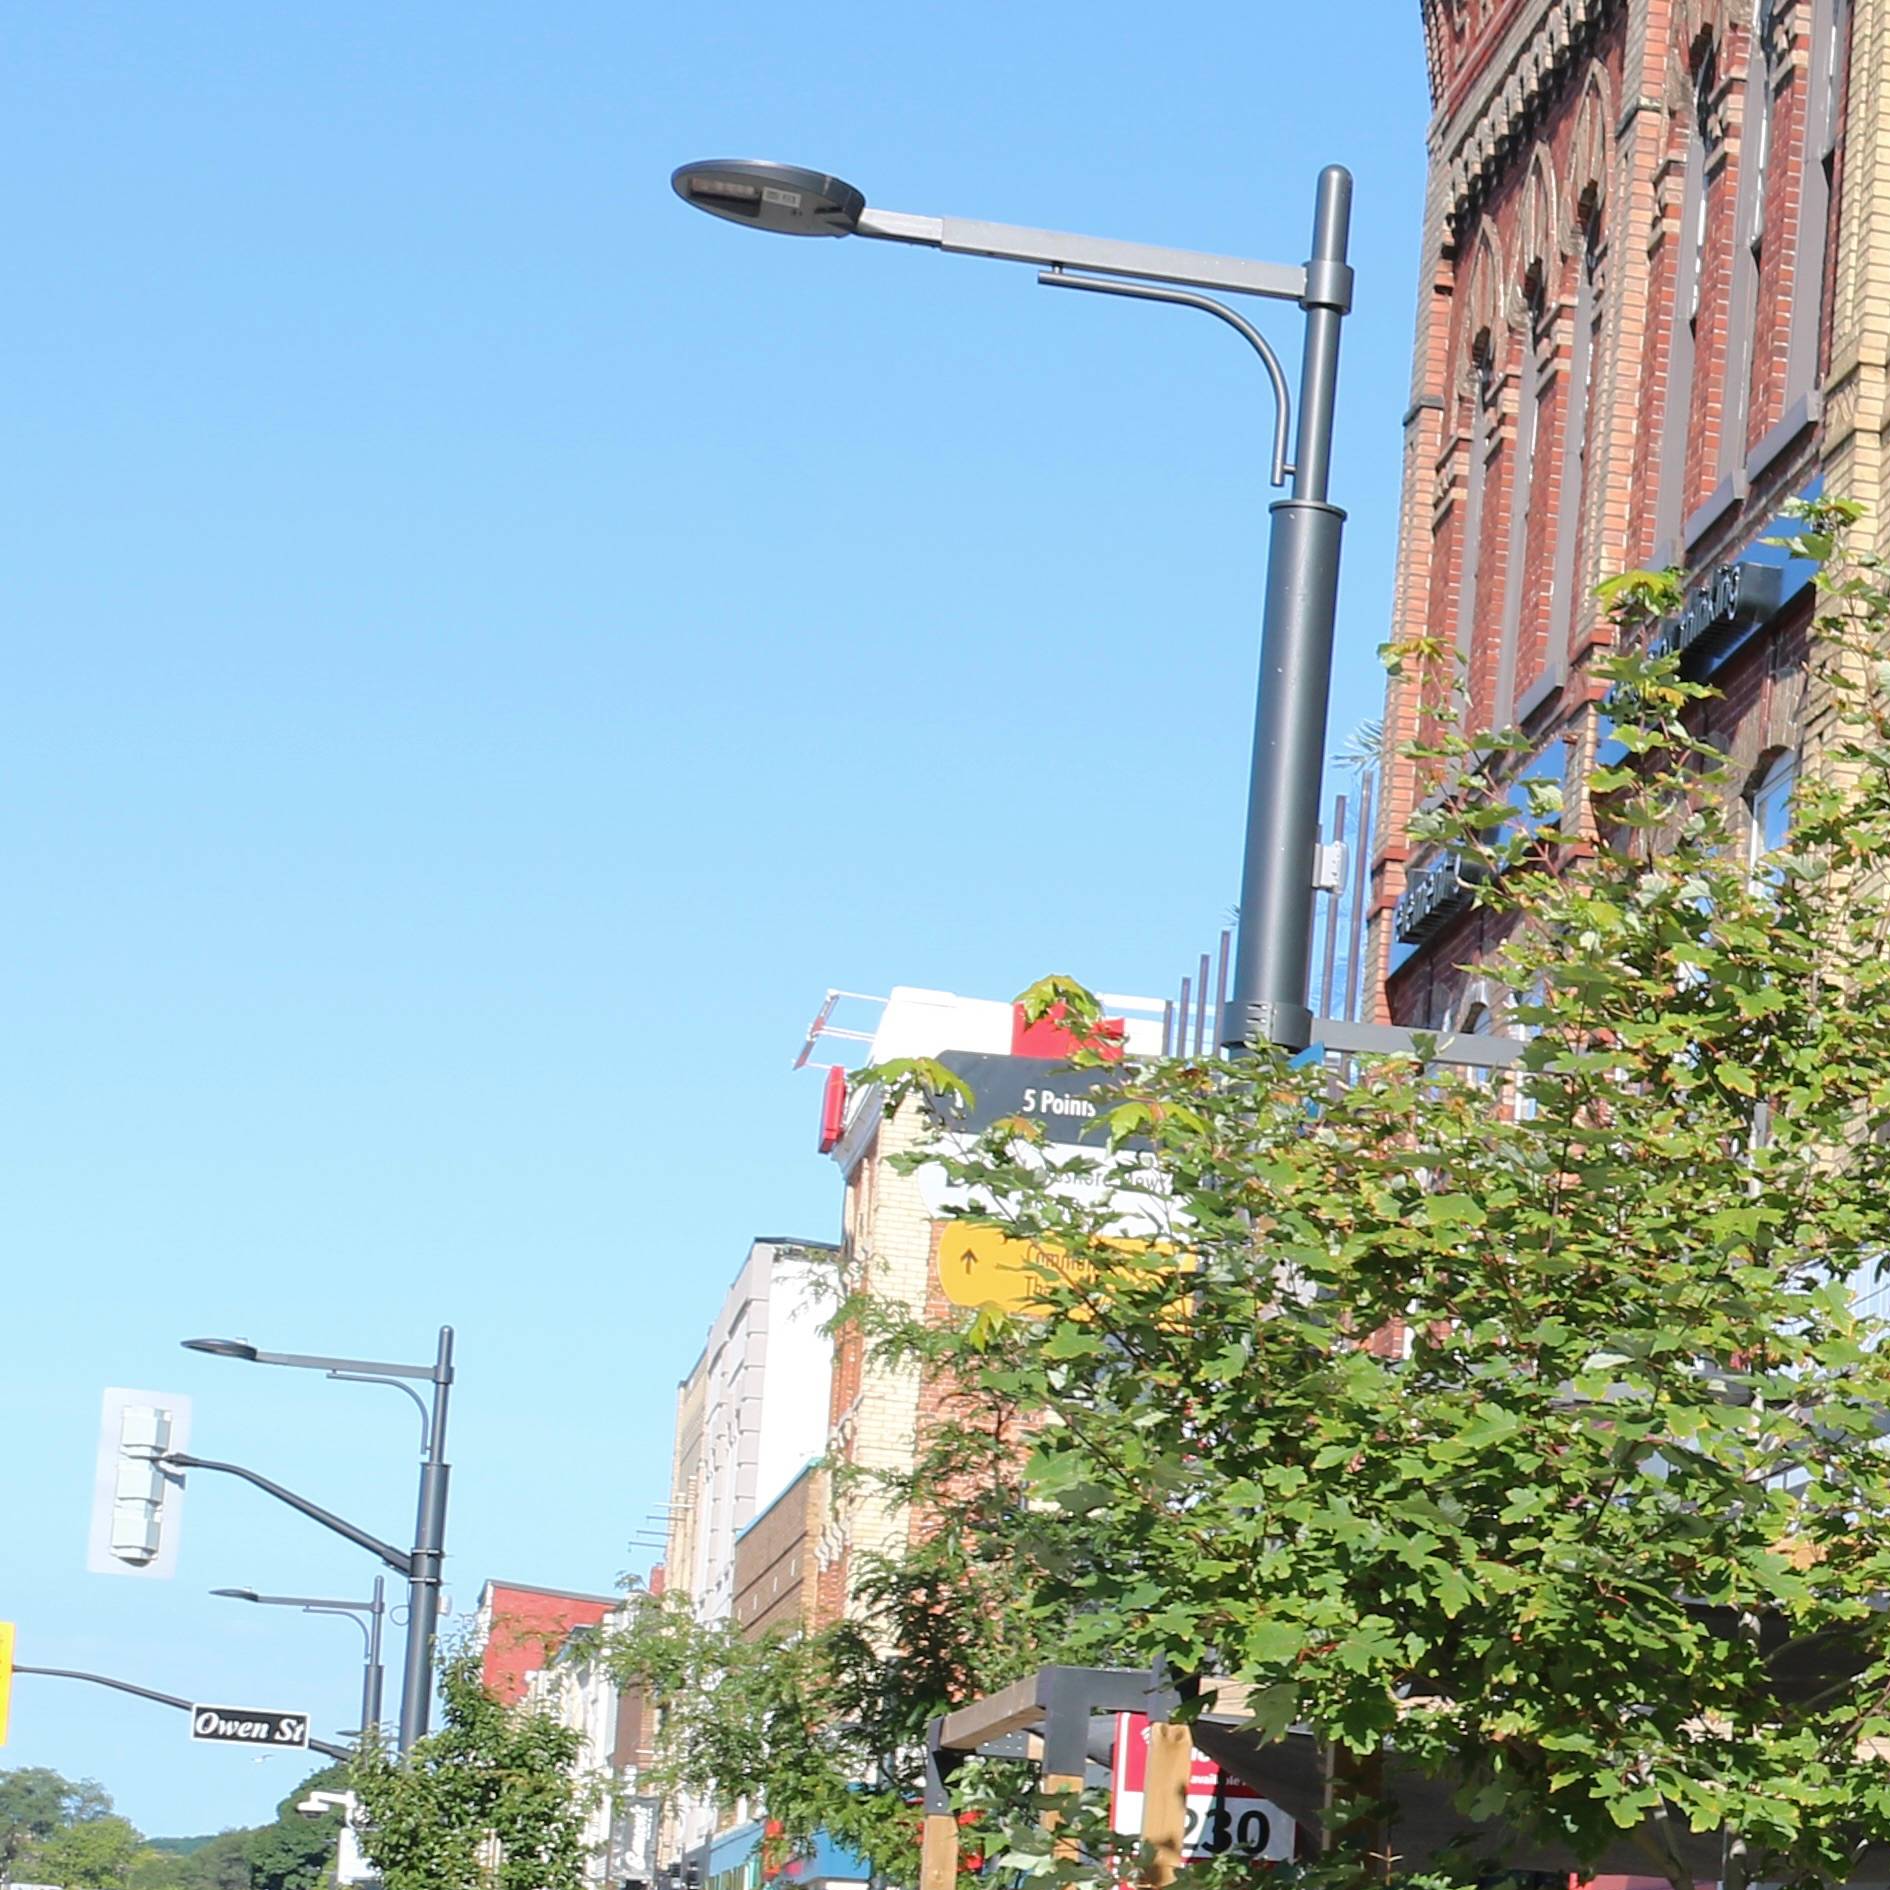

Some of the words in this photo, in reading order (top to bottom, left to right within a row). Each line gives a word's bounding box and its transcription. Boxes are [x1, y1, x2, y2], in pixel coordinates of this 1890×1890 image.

[1022, 1088, 1037, 1112] 5
[195, 1711, 271, 1739] Owen
[273, 1718, 305, 1742] St
